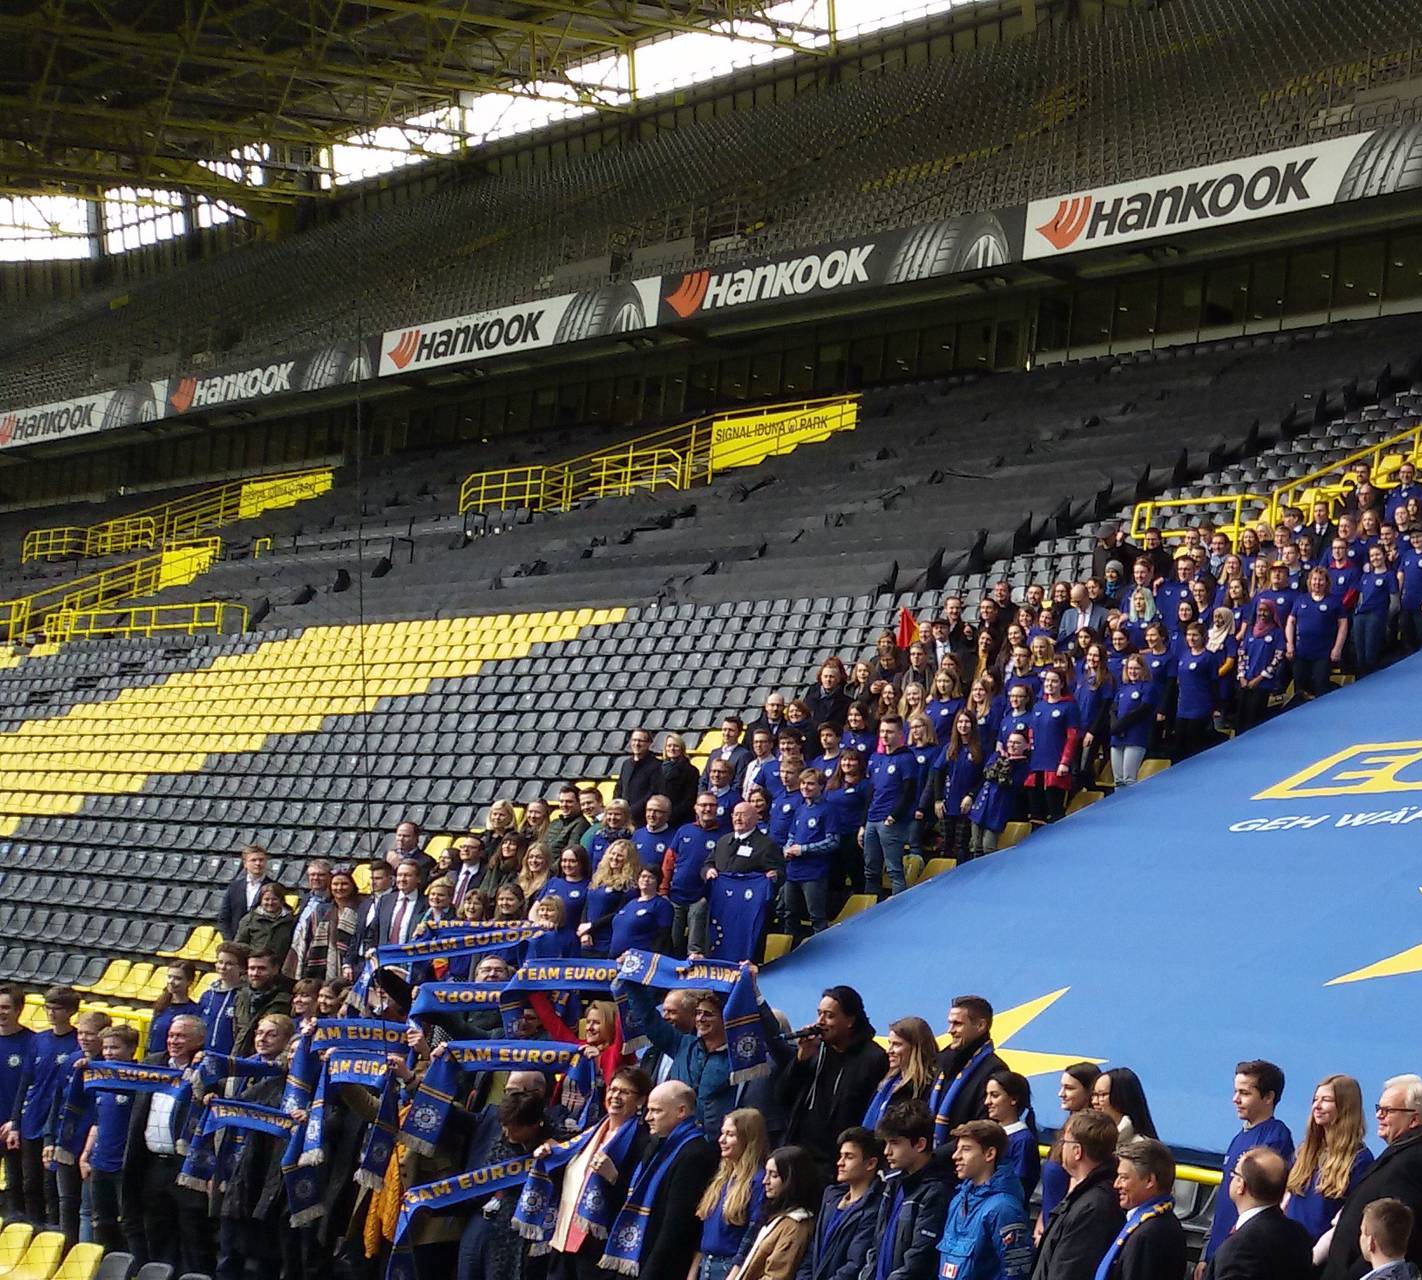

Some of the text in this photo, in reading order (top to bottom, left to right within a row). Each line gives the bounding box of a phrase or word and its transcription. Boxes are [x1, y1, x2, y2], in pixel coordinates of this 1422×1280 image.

[716, 415, 829, 442] SIGNAL IDUNA PARK
[1229, 815, 1330, 833] GEH
[400, 937, 457, 956] TEAM
[516, 966, 618, 981] TEAM EUROP
[434, 989, 501, 1004] UROPA
[315, 1026, 342, 1041] AM
[452, 1047, 580, 1068] EAM EUROPA
[404, 1157, 535, 1204] EAM EUROP
